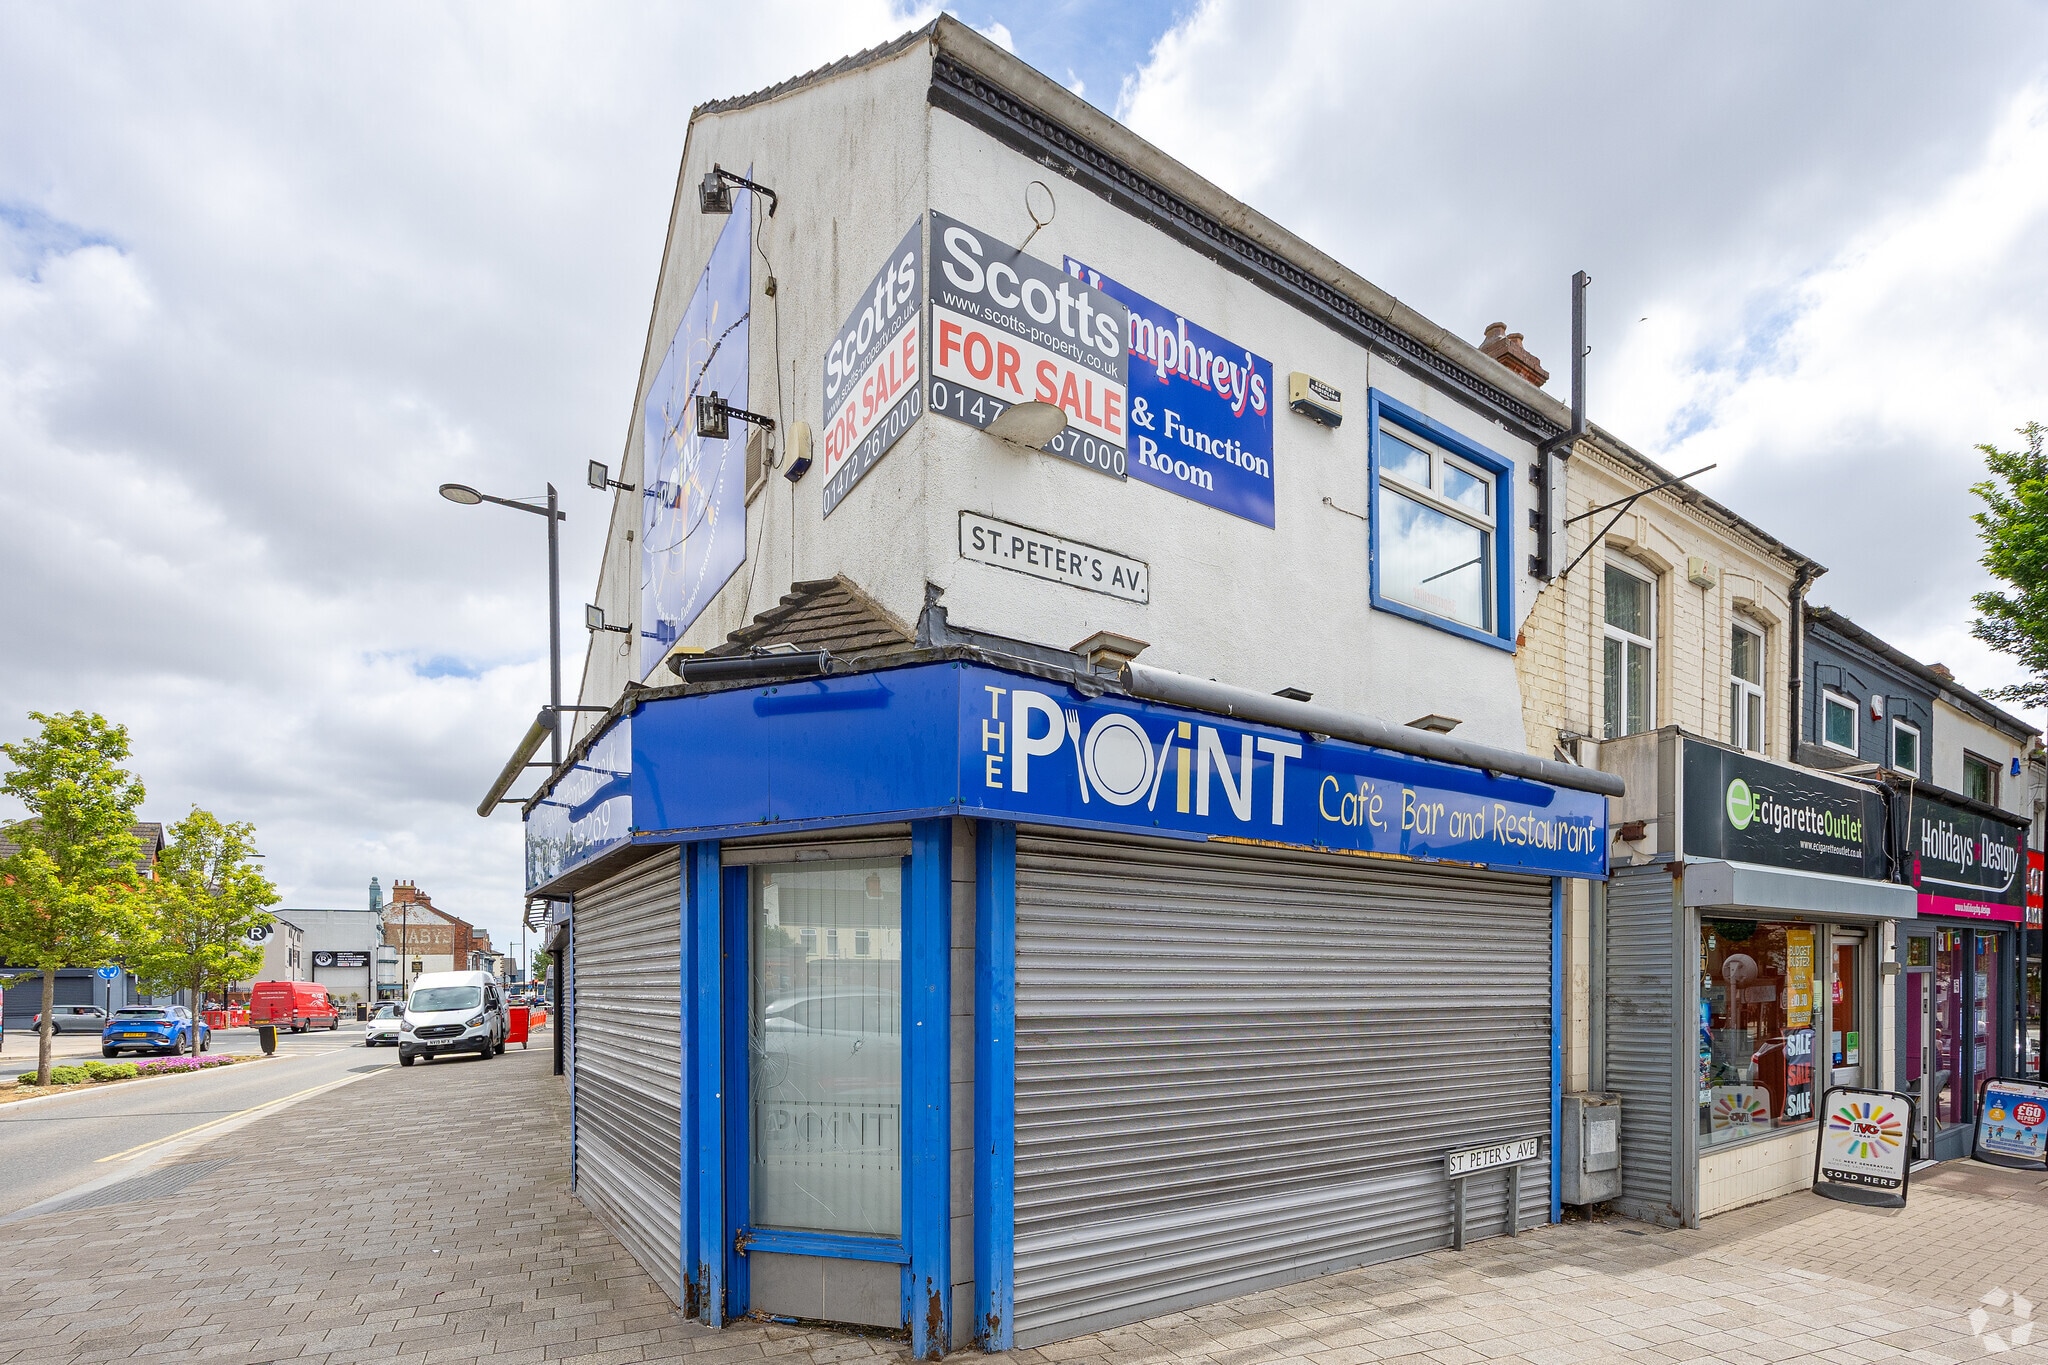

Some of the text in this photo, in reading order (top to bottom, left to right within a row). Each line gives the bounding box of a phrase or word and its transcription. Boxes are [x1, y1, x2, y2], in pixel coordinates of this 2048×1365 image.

[942, 227, 1119, 357] Scotts
[826, 252, 915, 399] Scotts
[943, 291, 1118, 378] www.scotts-property.co.uk
[1068, 260, 1265, 413] mphrey's
[826, 300, 915, 420] www.scotts-property.co.uk
[940, 319, 1121, 436] FOR SALE
[825, 327, 916, 476] FOR SALE
[932, 382, 1125, 475] 0147 67000
[823, 388, 920, 513] 01472 267000
[1131, 397, 1269, 479] & Function
[1138, 435, 1213, 491] Room
[1112, 566, 1145, 593] AV.
[982, 685, 1006, 789] THE
[1319, 775, 1596, 855] Café, Bar and Restaurant
[1753, 793, 1862, 843] EcigaretteOutlet
[1800, 841, 1862, 859] www.ecigaretteoutlet.co.uk
[1921, 818, 1973, 874] Holidays
[250, 927, 263, 939] R
[1787, 1033, 1811, 1056] SALE
[1787, 1064, 1811, 1087] SALE
[1787, 1091, 1811, 1117] SALE
[1853, 1122, 1880, 1135] IVG
[2017, 1114, 2041, 1123] DEPOSIT
[2018, 1106, 2041, 1117] £60
[1450, 1140, 1535, 1172] ST PETER'S AVE
[1827, 1170, 1896, 1187] SOLD HERE
[1859, 1162, 1894, 1170] GENERATION
